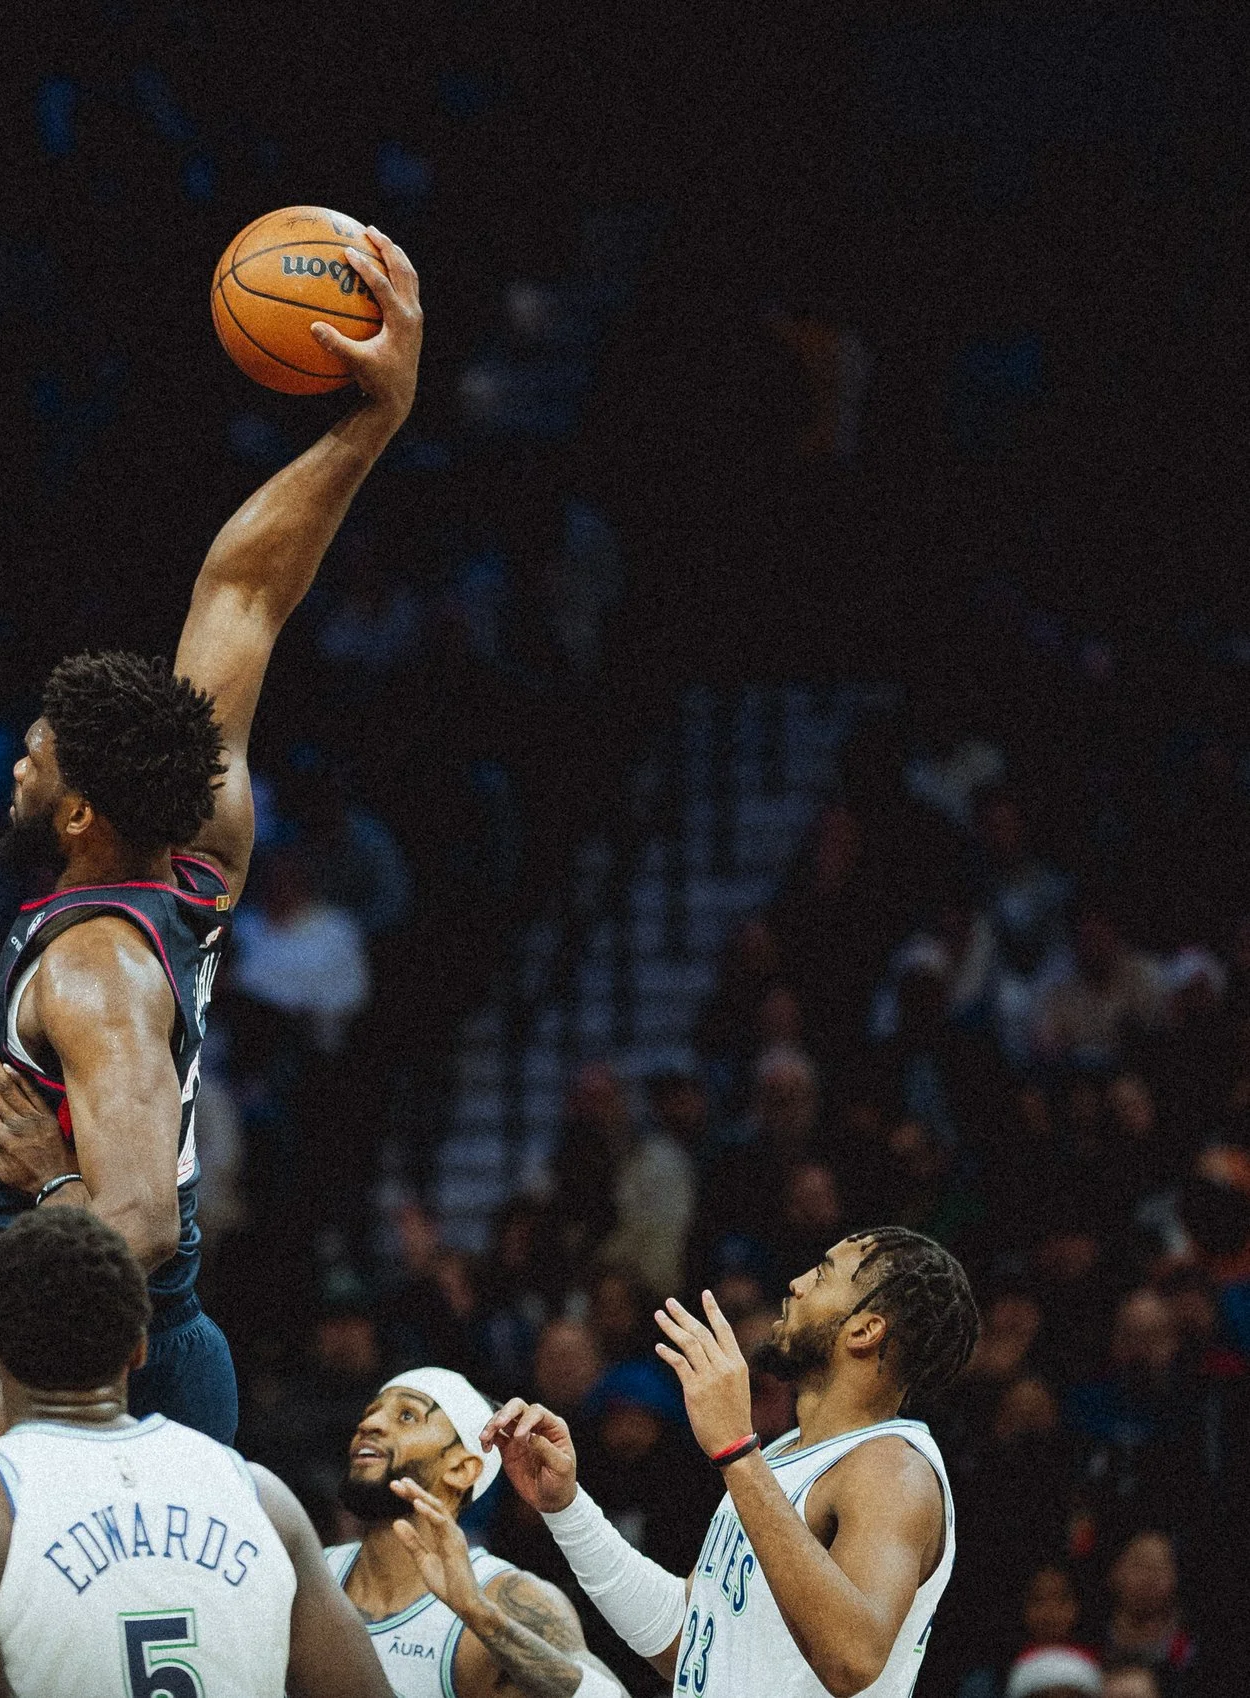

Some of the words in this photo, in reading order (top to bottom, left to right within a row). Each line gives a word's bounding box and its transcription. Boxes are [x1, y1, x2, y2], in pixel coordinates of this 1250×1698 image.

[44, 1502, 258, 1594] EDWARDS
[118, 1607, 206, 1698] 5
[677, 1604, 716, 1698] 23
